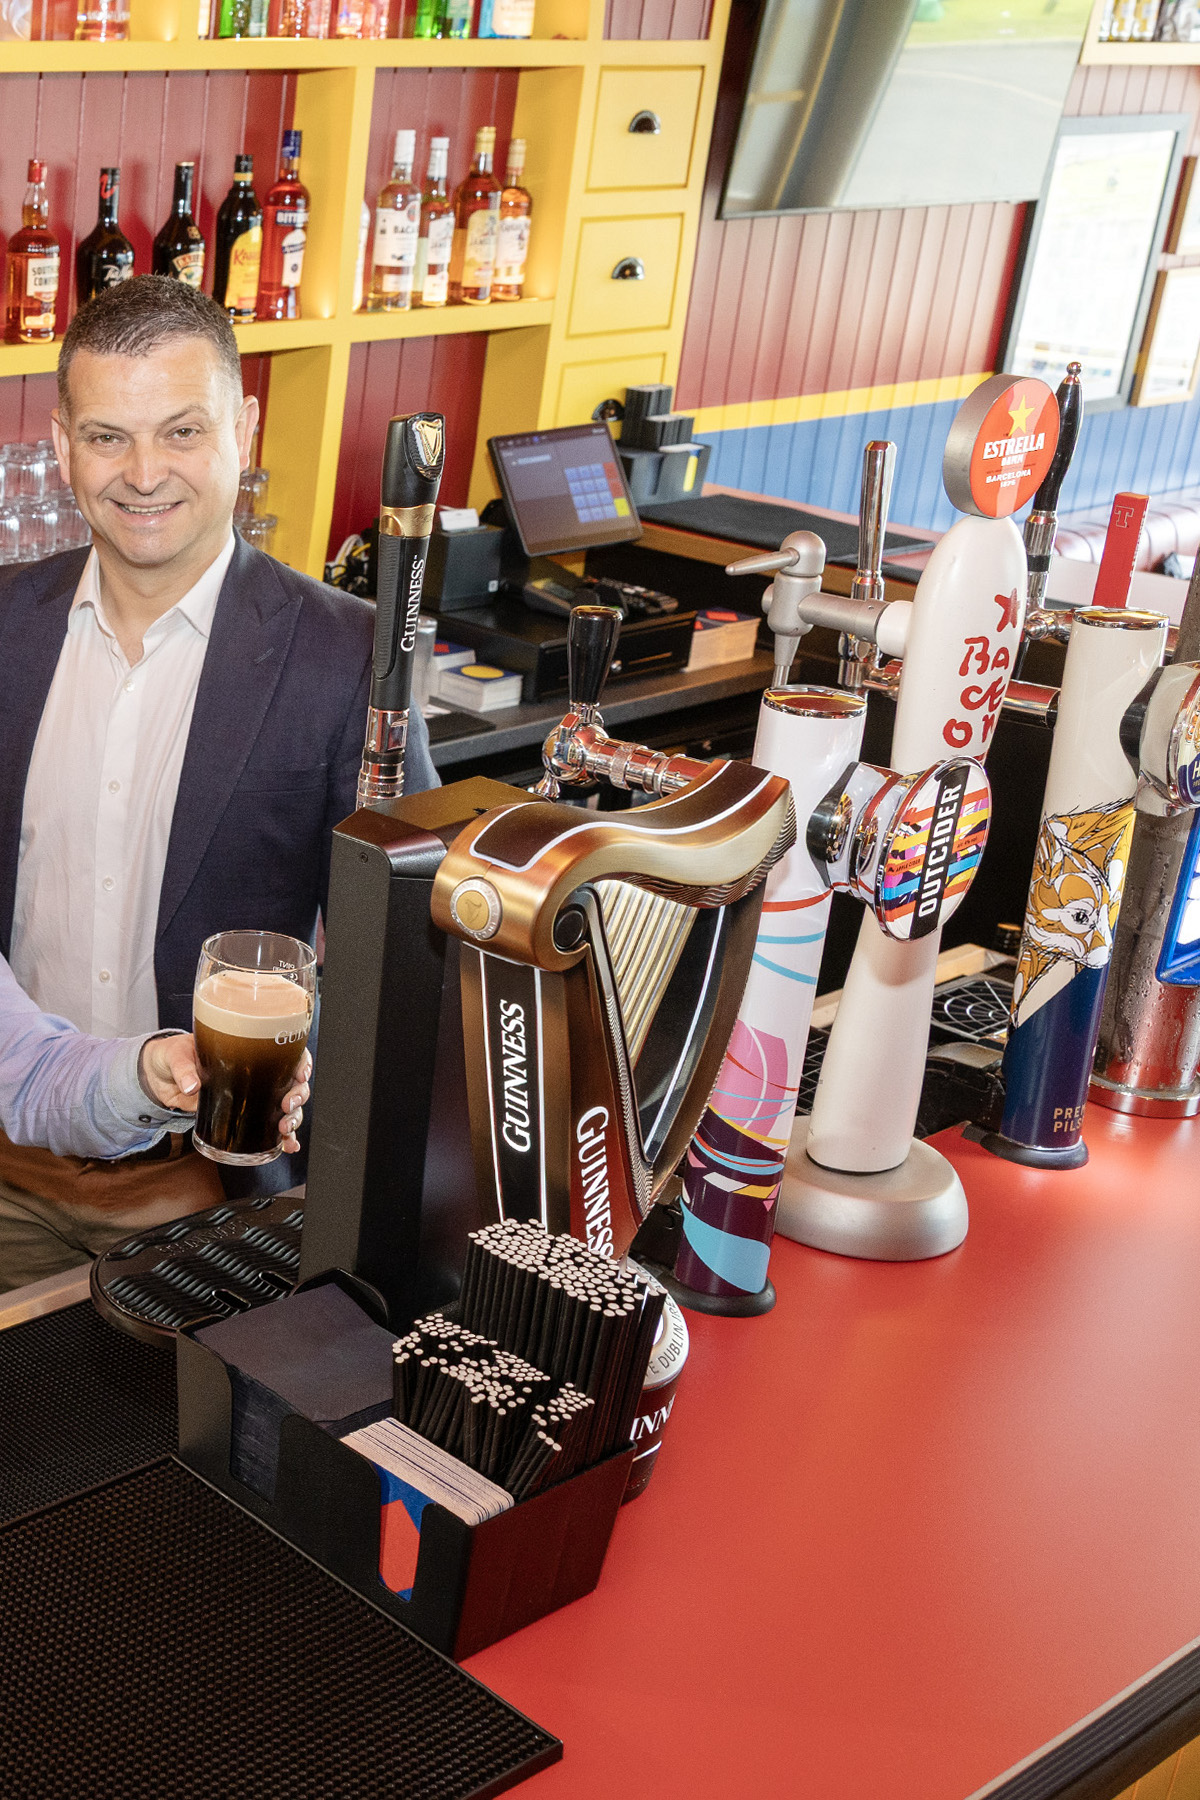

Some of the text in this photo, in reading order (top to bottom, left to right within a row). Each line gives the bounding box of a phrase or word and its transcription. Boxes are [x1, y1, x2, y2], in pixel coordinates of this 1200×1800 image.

[983, 432, 1046, 460] ESTRELLA
[985, 469, 1032, 484] BARCELONA
[1000, 479, 1017, 488] 1876
[1114, 504, 1135, 528] T
[401, 557, 425, 652] GUINNESS
[895, 858, 921, 873] APPLE CIDER
[500, 1000, 532, 1153] GUINNESS
[576, 1105, 614, 1260] GUINNESS
